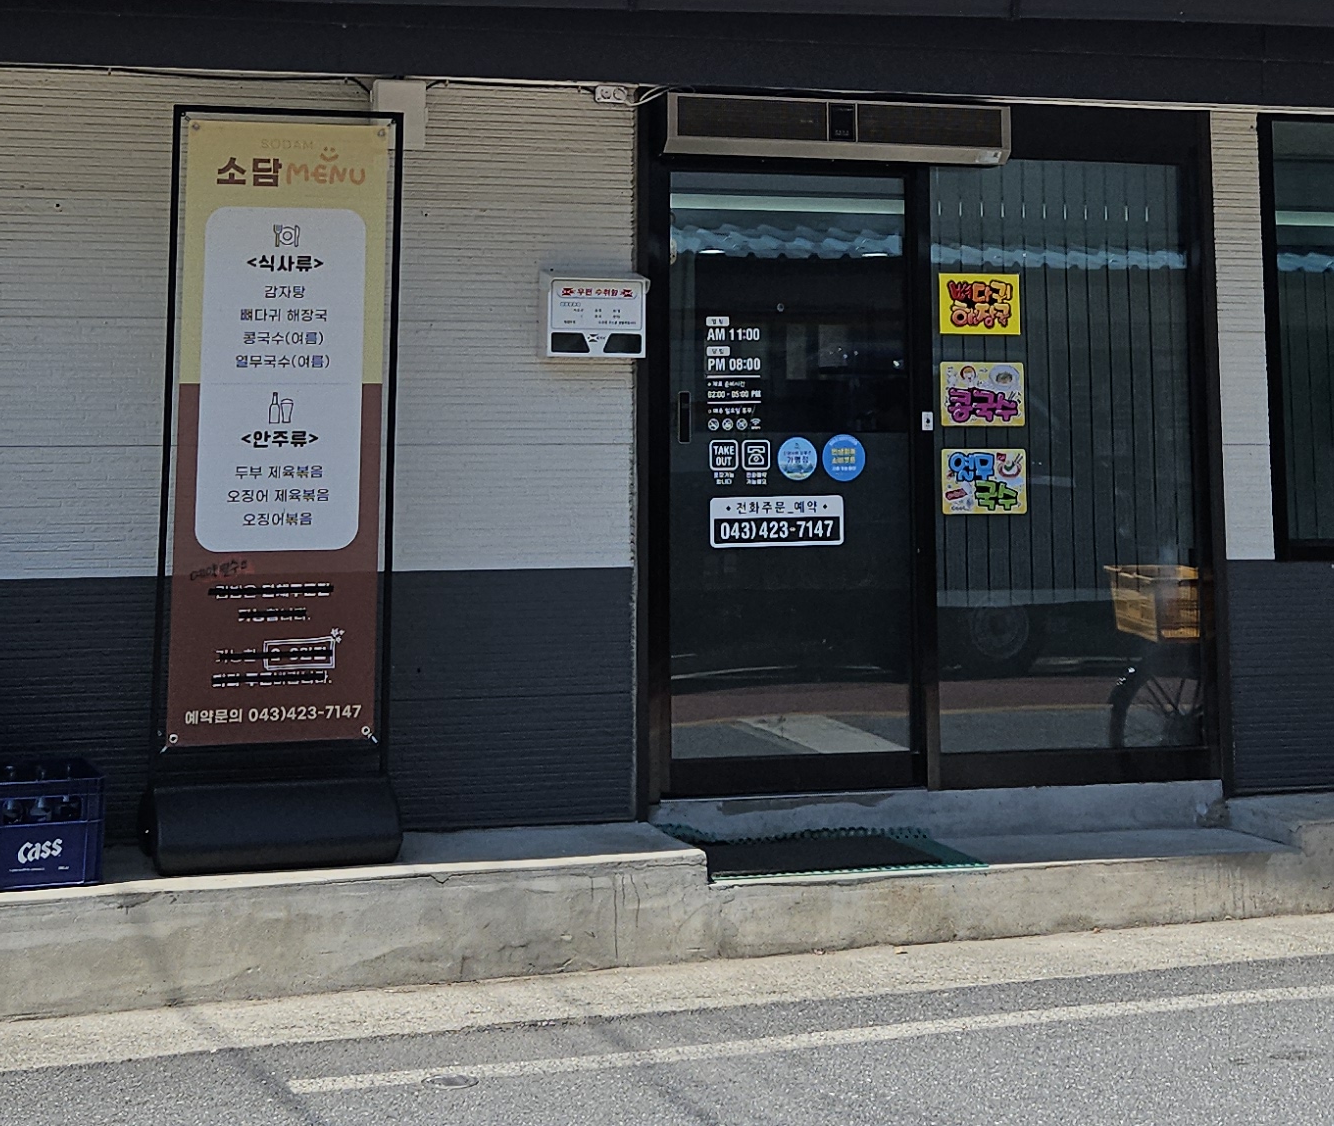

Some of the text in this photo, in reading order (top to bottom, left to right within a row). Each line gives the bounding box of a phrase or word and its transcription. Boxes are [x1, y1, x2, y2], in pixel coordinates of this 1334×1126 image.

[261, 139, 314, 150] SODAM
[216, 157, 366, 187] 소담 MENU
[264, 285, 306, 299] 감자탕
[240, 308, 328, 322] 뼈다귀 해장국
[243, 331, 324, 346] 콩국수(여름)
[707, 328, 760, 341] AM 11:00
[708, 358, 761, 371] PM 08:00
[948, 387, 1018, 422] 콩국수
[713, 445, 735, 455] TAKE
[715, 456, 732, 466] OUT
[949, 452, 995, 481] 열무
[234, 465, 323, 480] 두부 제육볶음
[227, 488, 329, 503] 오징어 제육볶음
[974, 480, 1018, 511] 국수
[242, 512, 312, 526] 오징어볶음
[720, 520, 834, 540] 043)423-7147
[185, 704, 362, 725] 예약문의 043)423-7147
[17, 838, 63, 864] Cass
